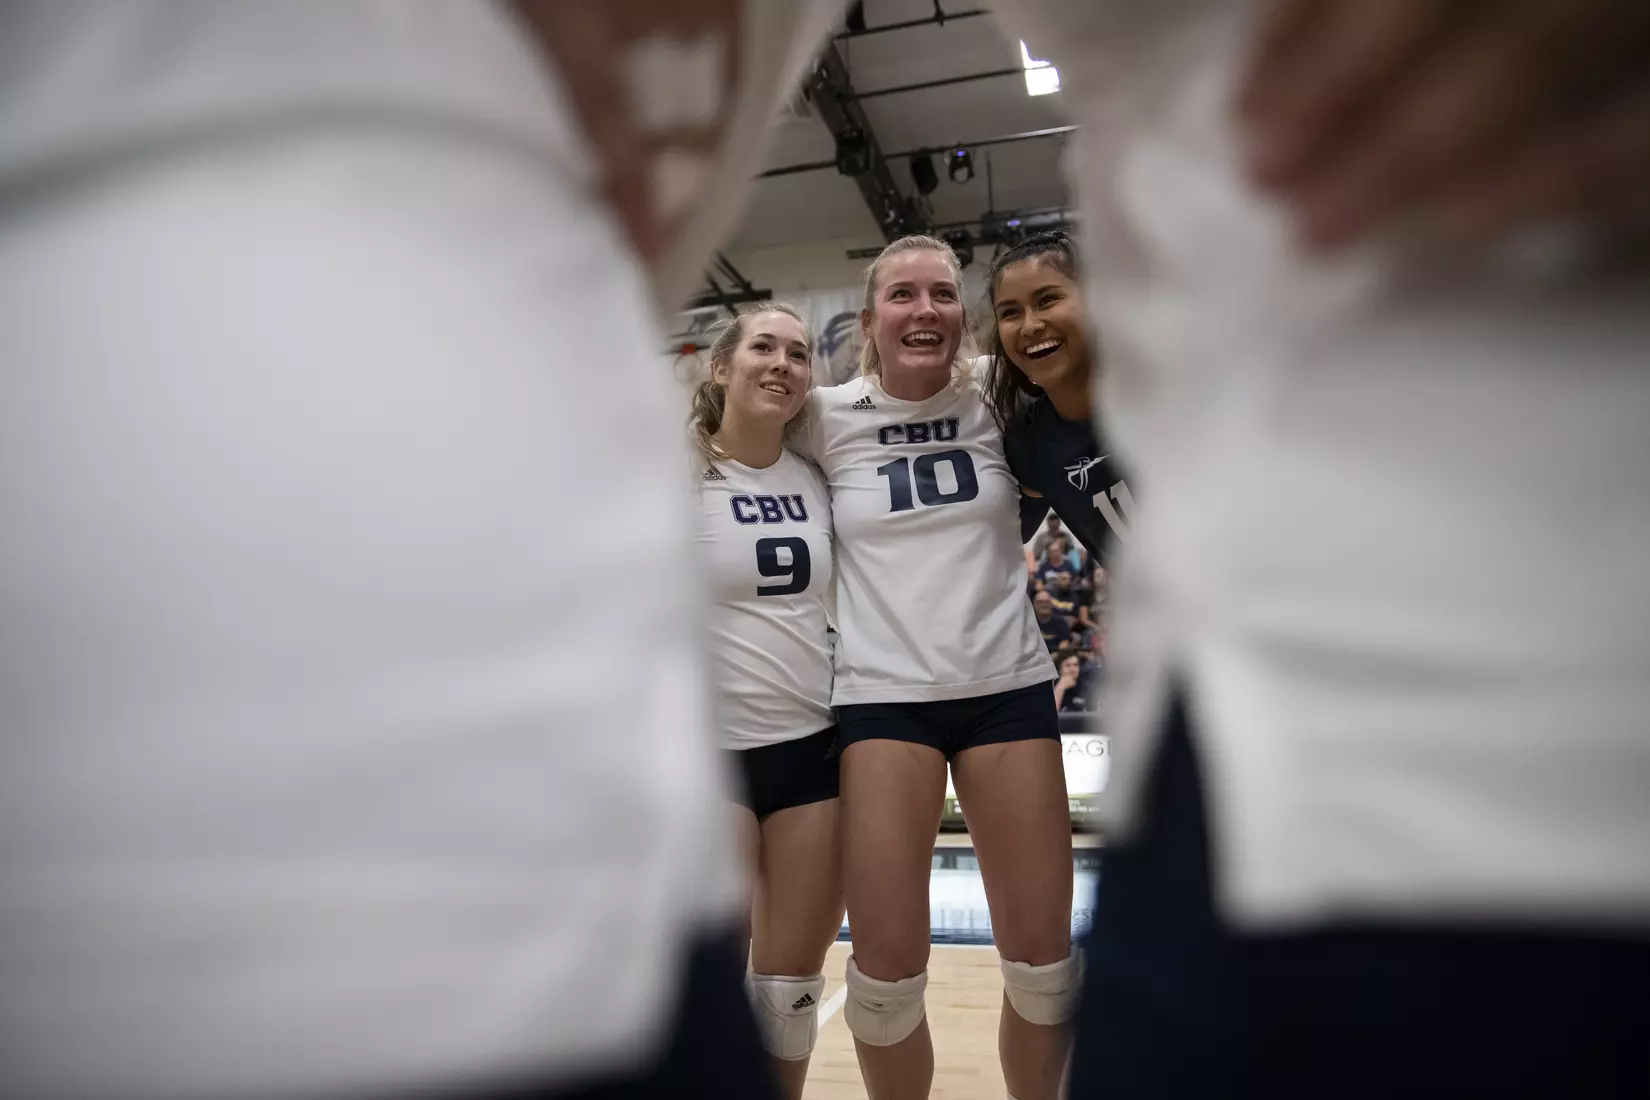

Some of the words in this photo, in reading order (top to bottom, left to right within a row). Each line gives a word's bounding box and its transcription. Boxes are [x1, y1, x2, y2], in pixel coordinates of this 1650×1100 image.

[852, 402, 877, 411] adidas
[878, 417, 960, 446] CBU
[877, 449, 980, 512] 10
[729, 493, 810, 525] CBU
[755, 536, 812, 596] 9
